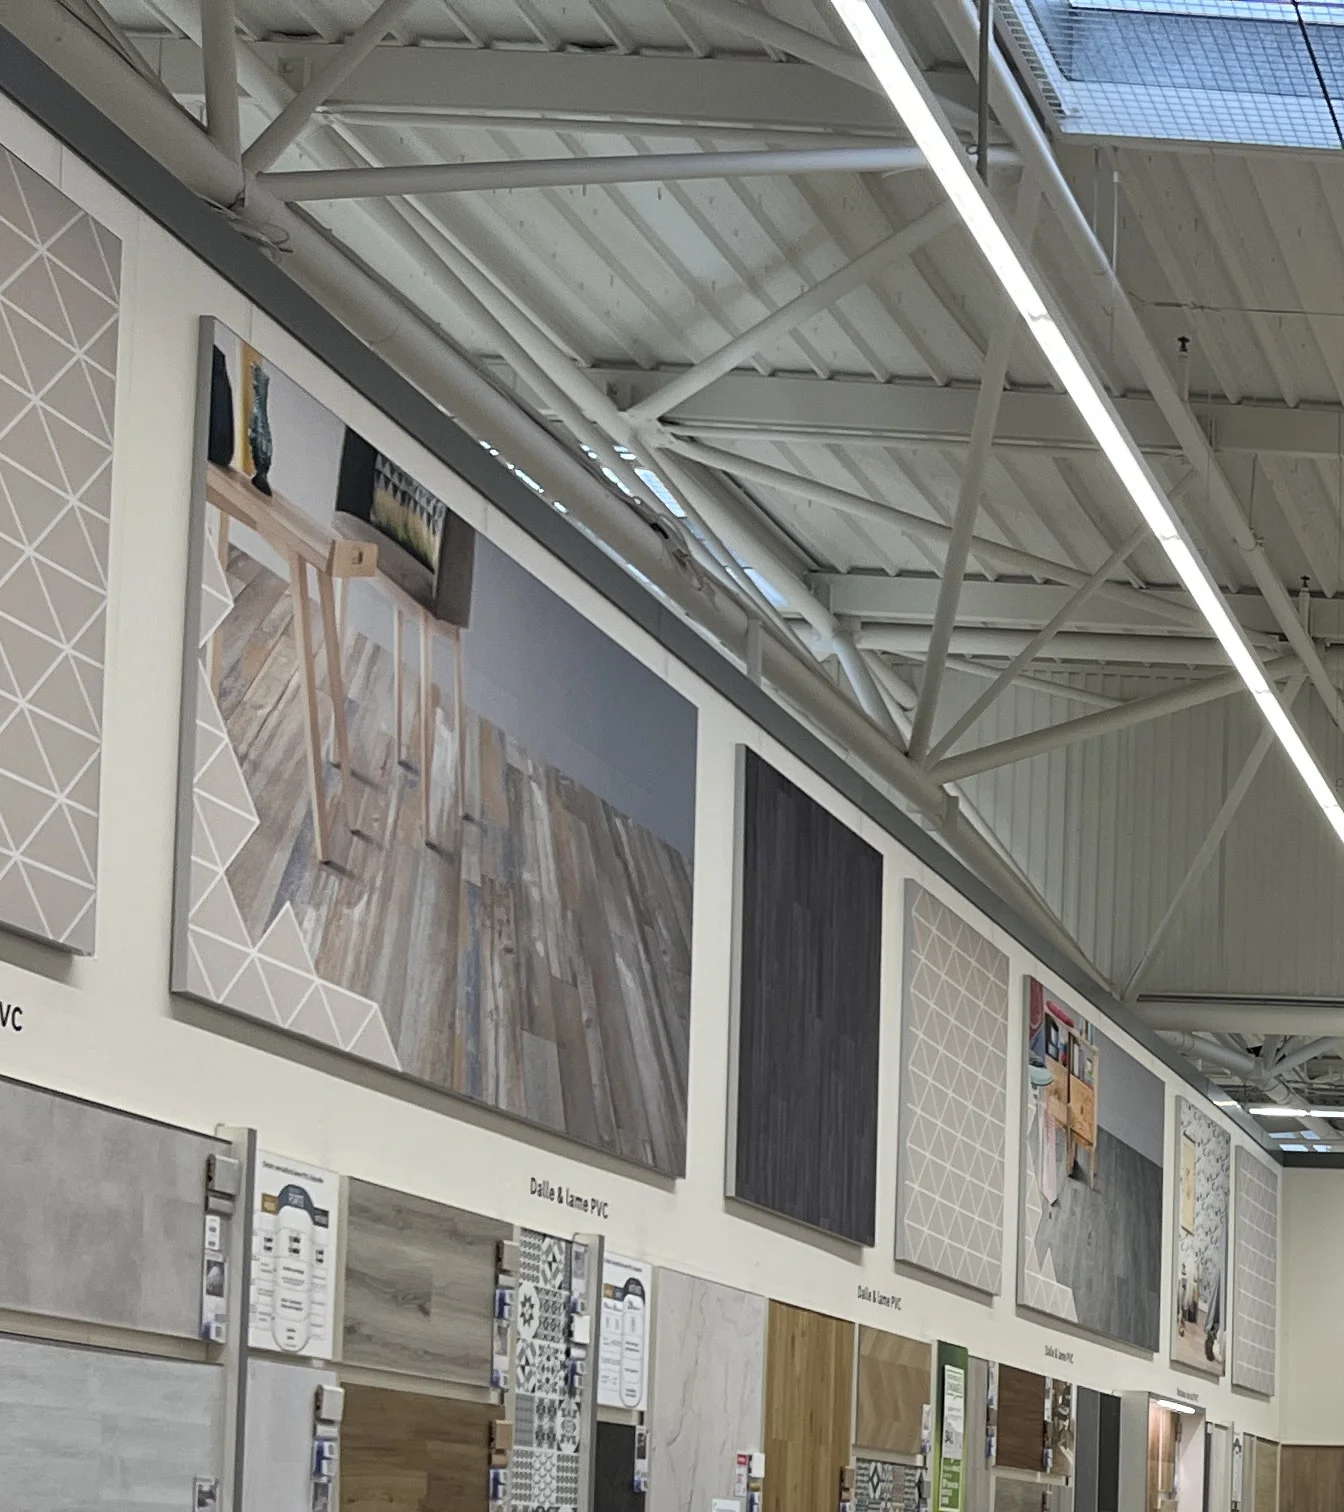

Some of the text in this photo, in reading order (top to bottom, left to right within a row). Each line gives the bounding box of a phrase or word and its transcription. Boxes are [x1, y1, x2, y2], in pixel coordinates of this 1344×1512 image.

[0, 1004, 23, 1033] VC
[530, 1177, 608, 1219] Dalle & lame PVC
